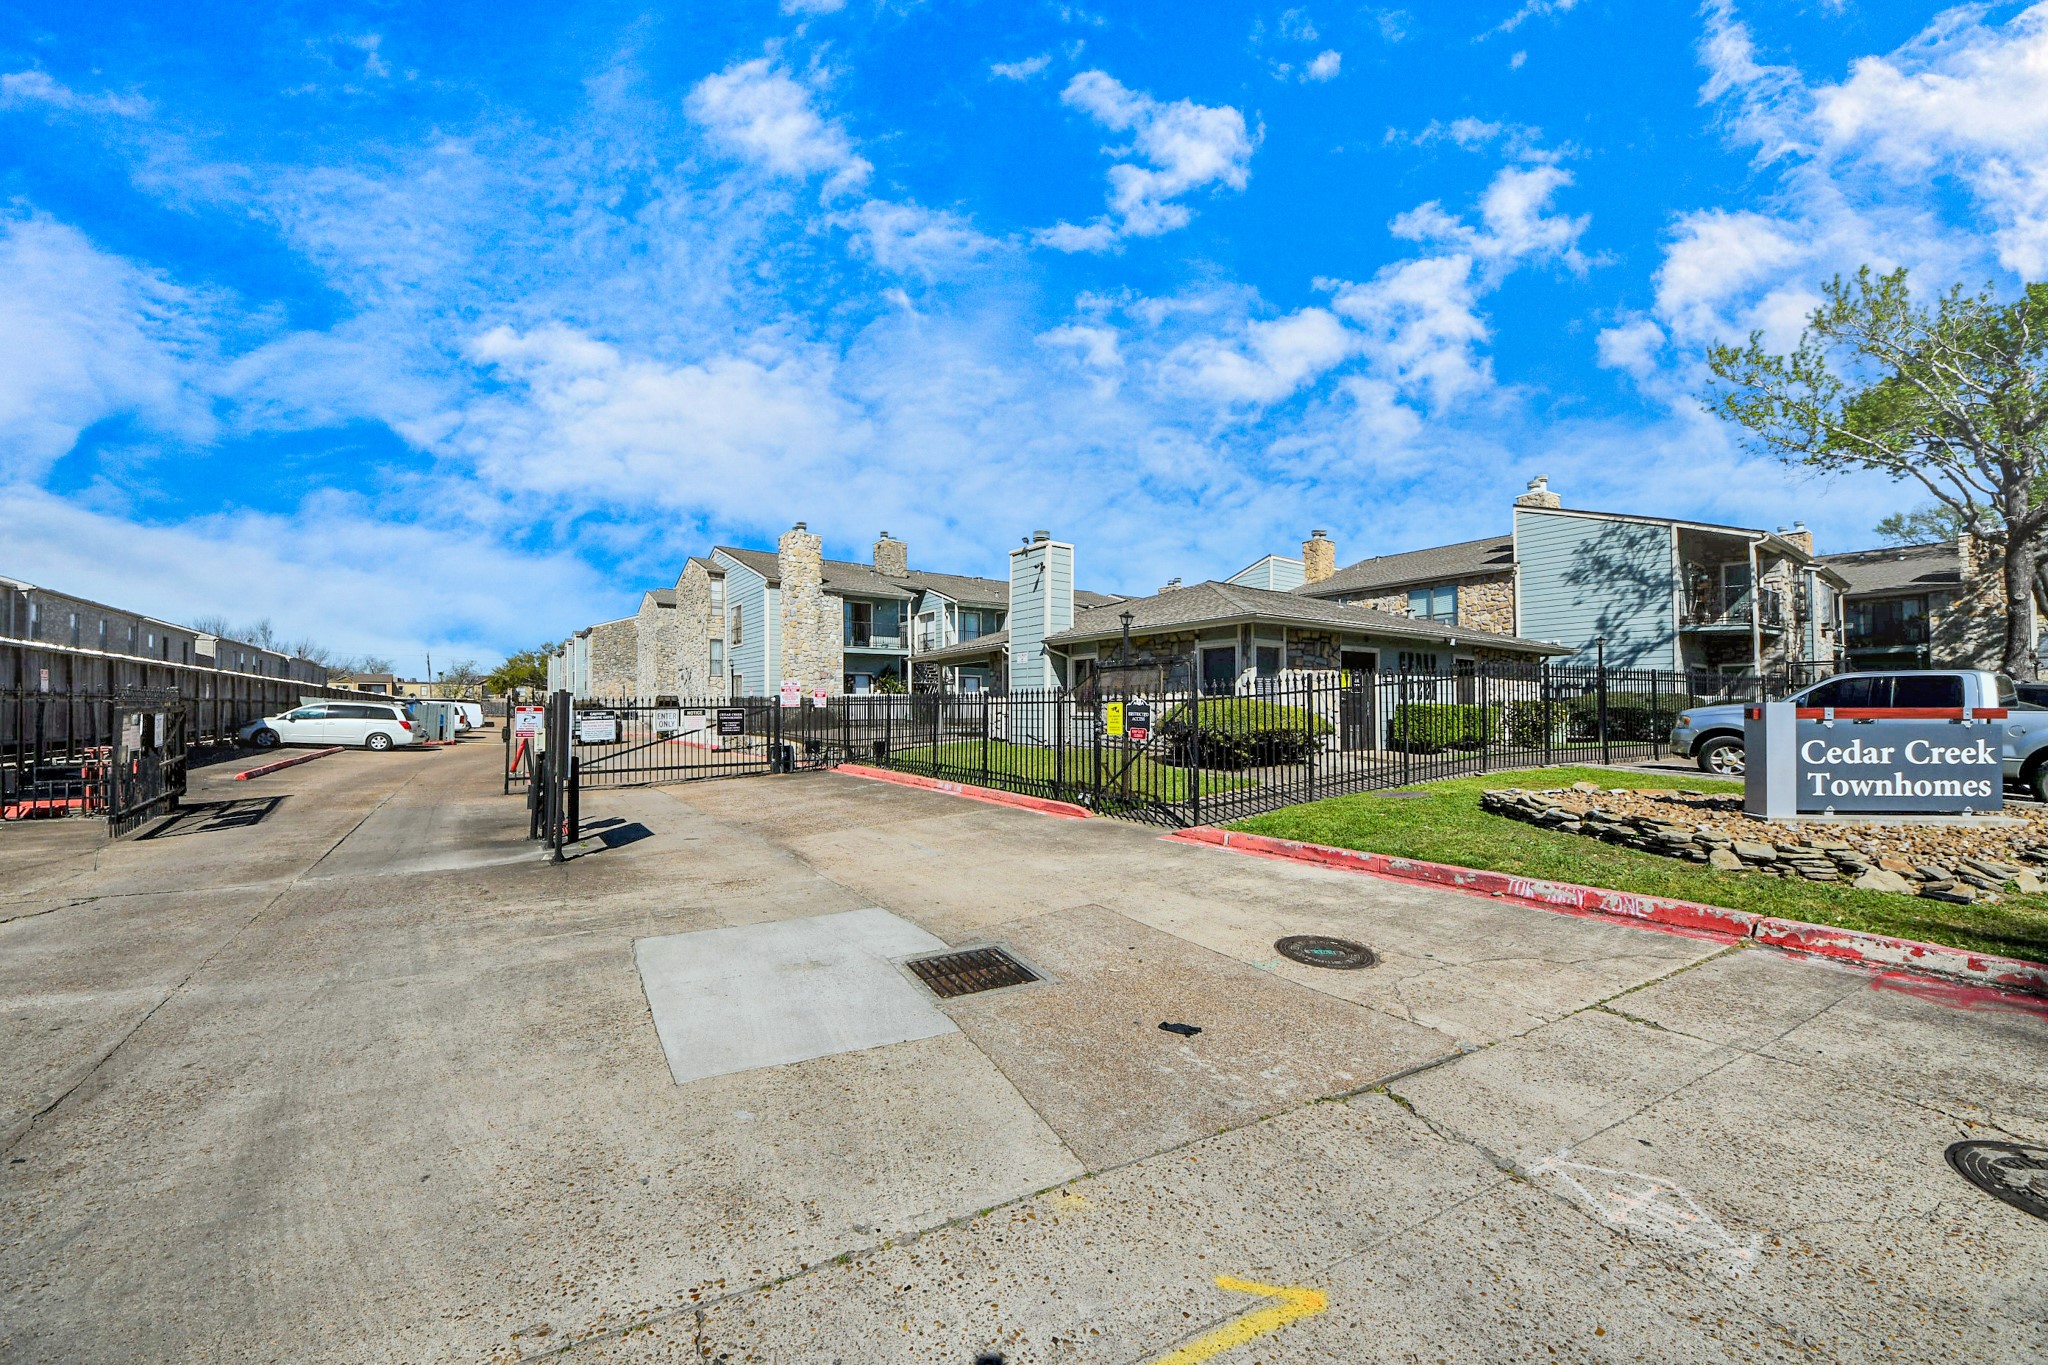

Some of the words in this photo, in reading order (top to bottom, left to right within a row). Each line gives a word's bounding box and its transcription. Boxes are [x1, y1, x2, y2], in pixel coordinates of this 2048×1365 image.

[657, 712, 677, 720] ENTER
[658, 720, 676, 728] ONLY
[1801, 738, 1895, 765] Cedar
[1904, 738, 1997, 765] Creek
[1807, 771, 1992, 798] Townhomes
